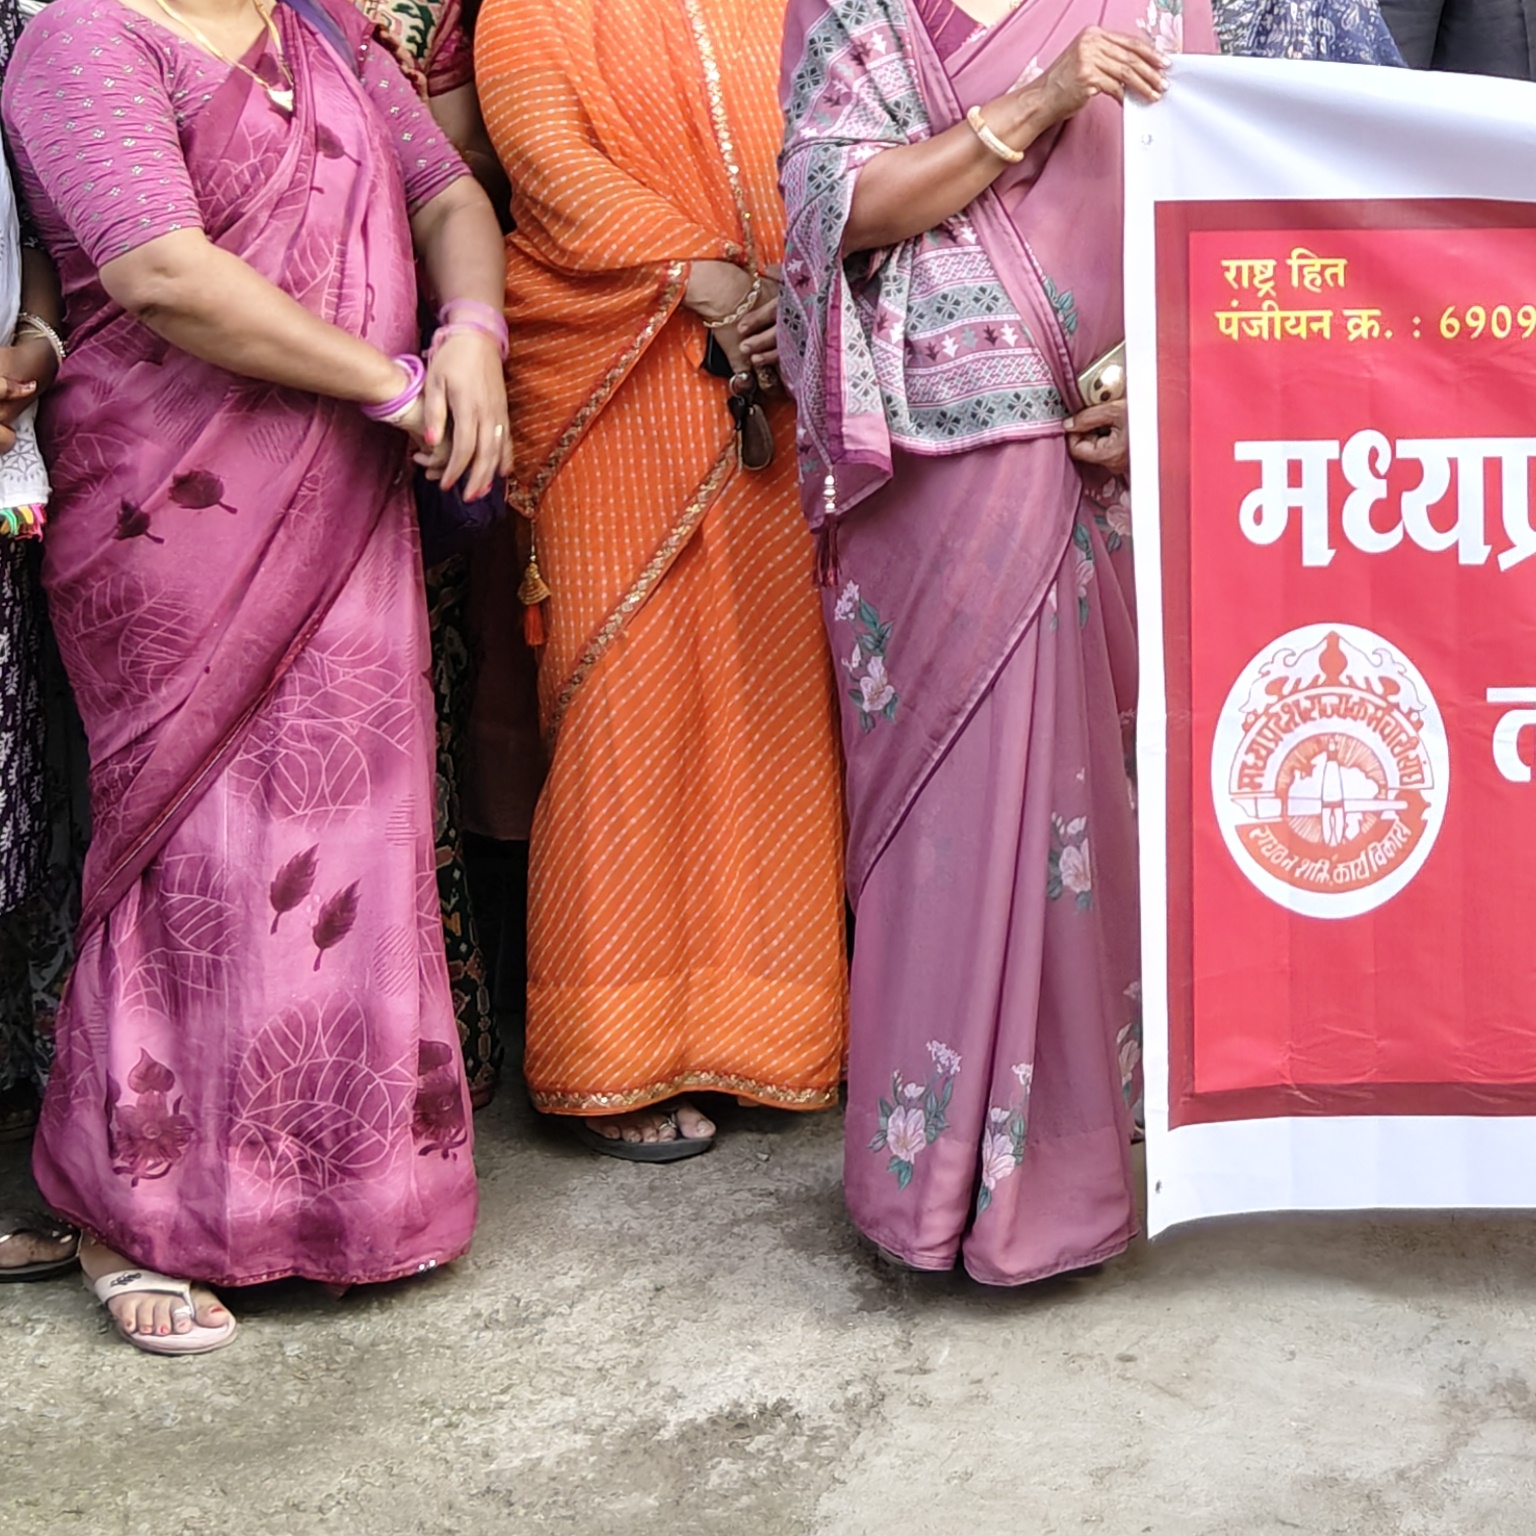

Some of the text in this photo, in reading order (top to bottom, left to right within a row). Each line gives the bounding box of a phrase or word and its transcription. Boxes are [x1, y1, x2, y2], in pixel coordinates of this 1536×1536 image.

[1221, 247, 1348, 297] राष्ट्र हित
[1214, 299, 1334, 341] पंजीयन
[1342, 308, 1394, 341] क्र.
